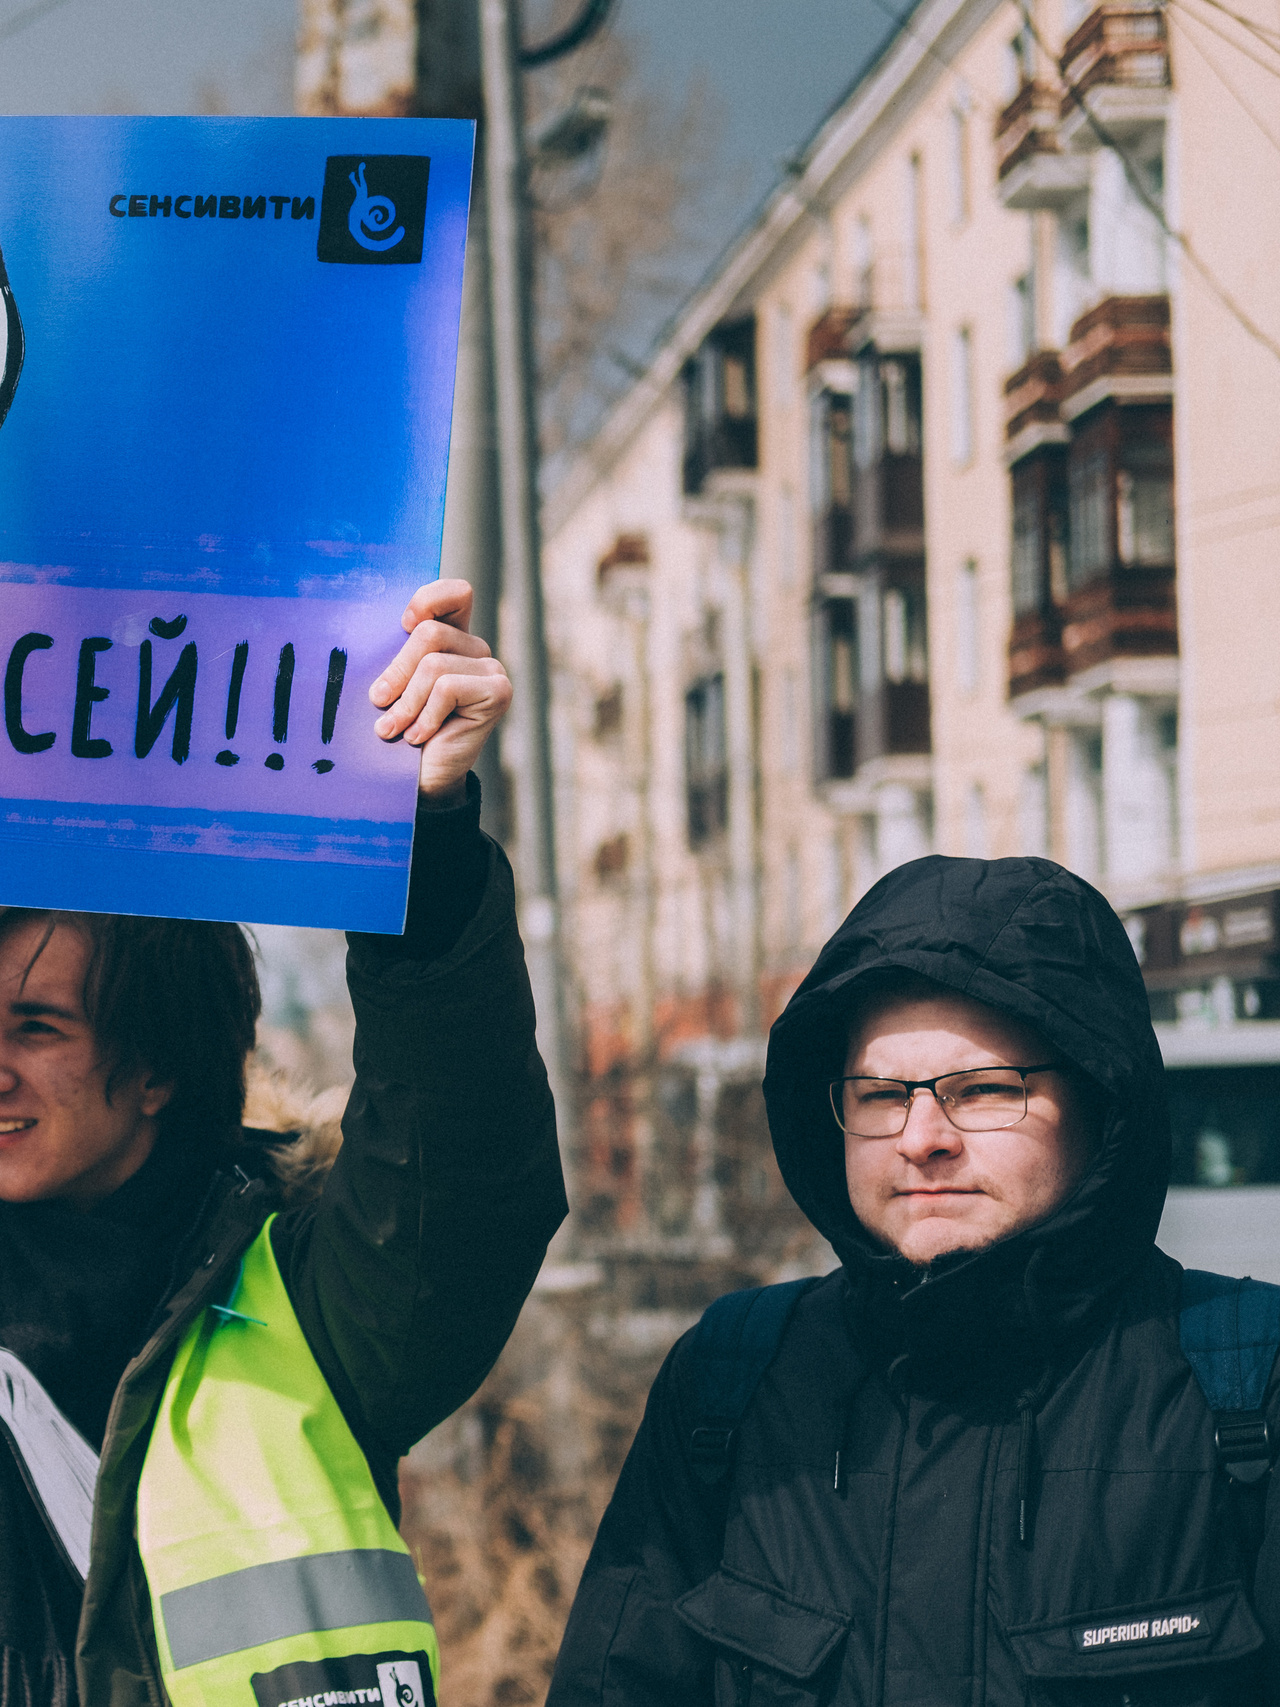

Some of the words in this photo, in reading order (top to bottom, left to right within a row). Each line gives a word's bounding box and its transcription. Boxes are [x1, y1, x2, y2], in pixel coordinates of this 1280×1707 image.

[108, 194, 316, 220] СЕНСИВИТИ
[1082, 1621, 1149, 1647] SUPERIOR
[1151, 1614, 1200, 1637] RAPID+
